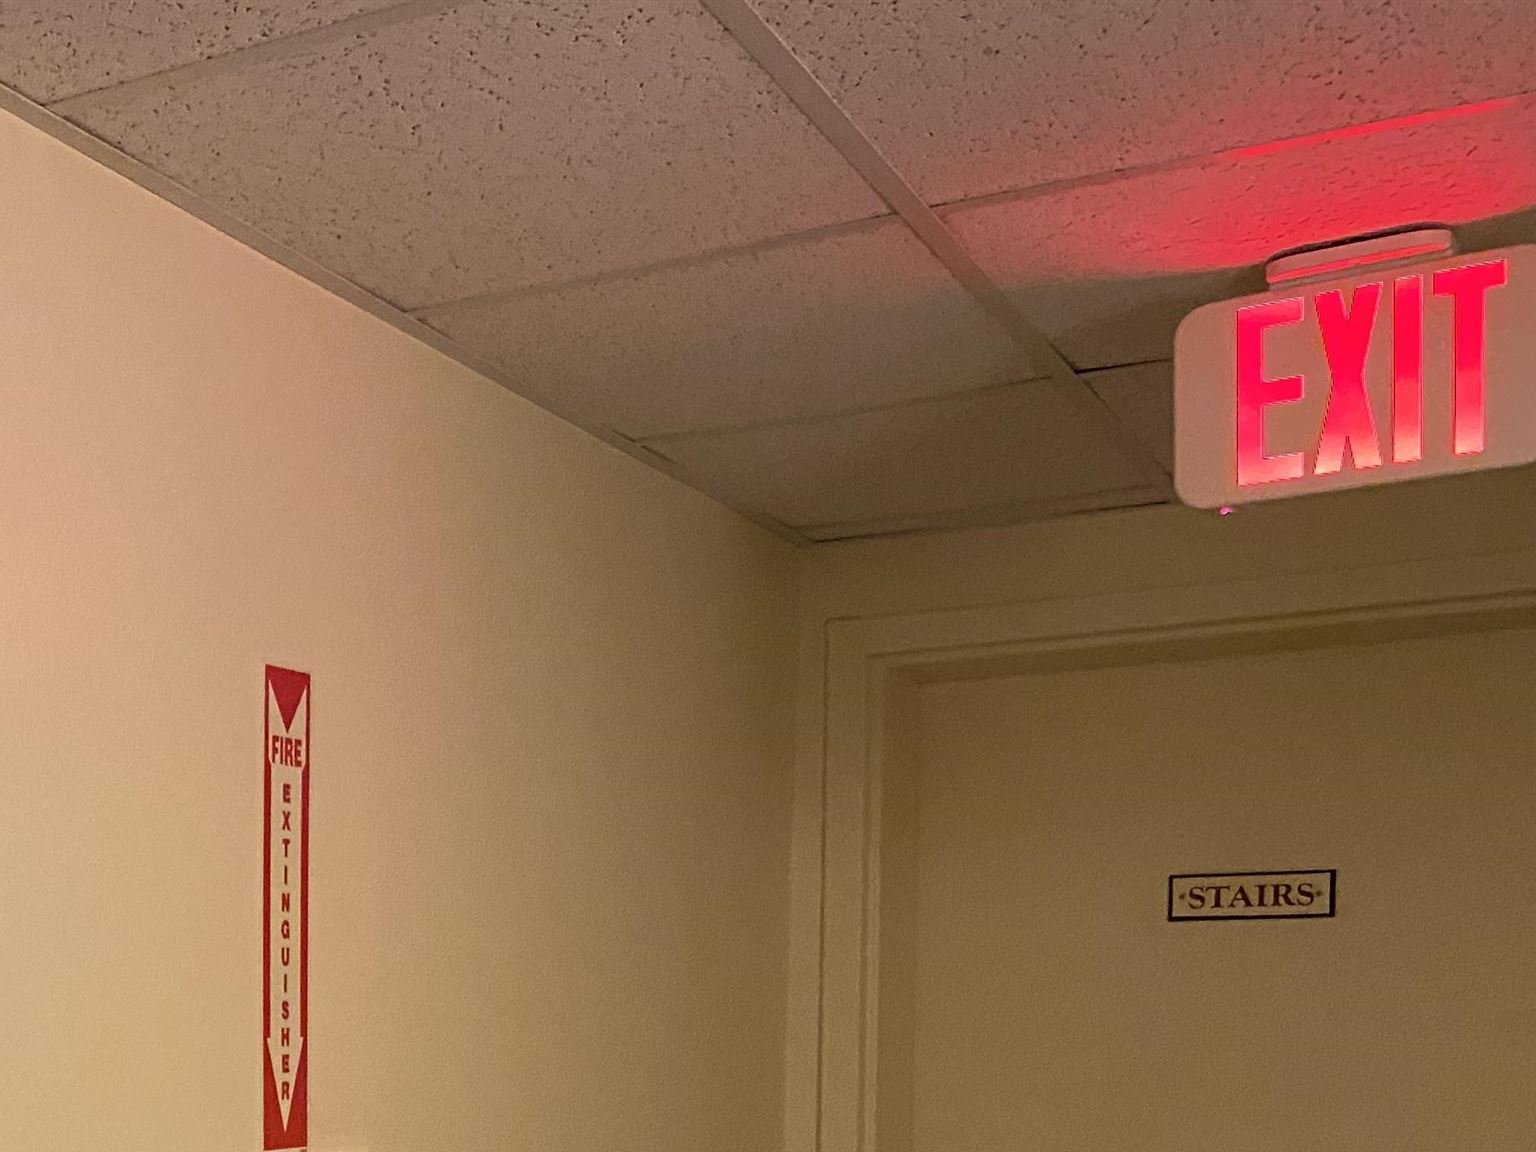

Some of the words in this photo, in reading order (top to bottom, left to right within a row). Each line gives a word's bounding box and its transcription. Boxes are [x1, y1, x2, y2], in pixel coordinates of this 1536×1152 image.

[1237, 258, 1508, 487] EXIT
[271, 735, 303, 767] FIRE
[281, 783, 292, 1101] EXTINGUISHER
[1188, 883, 1314, 909] STAIRS
